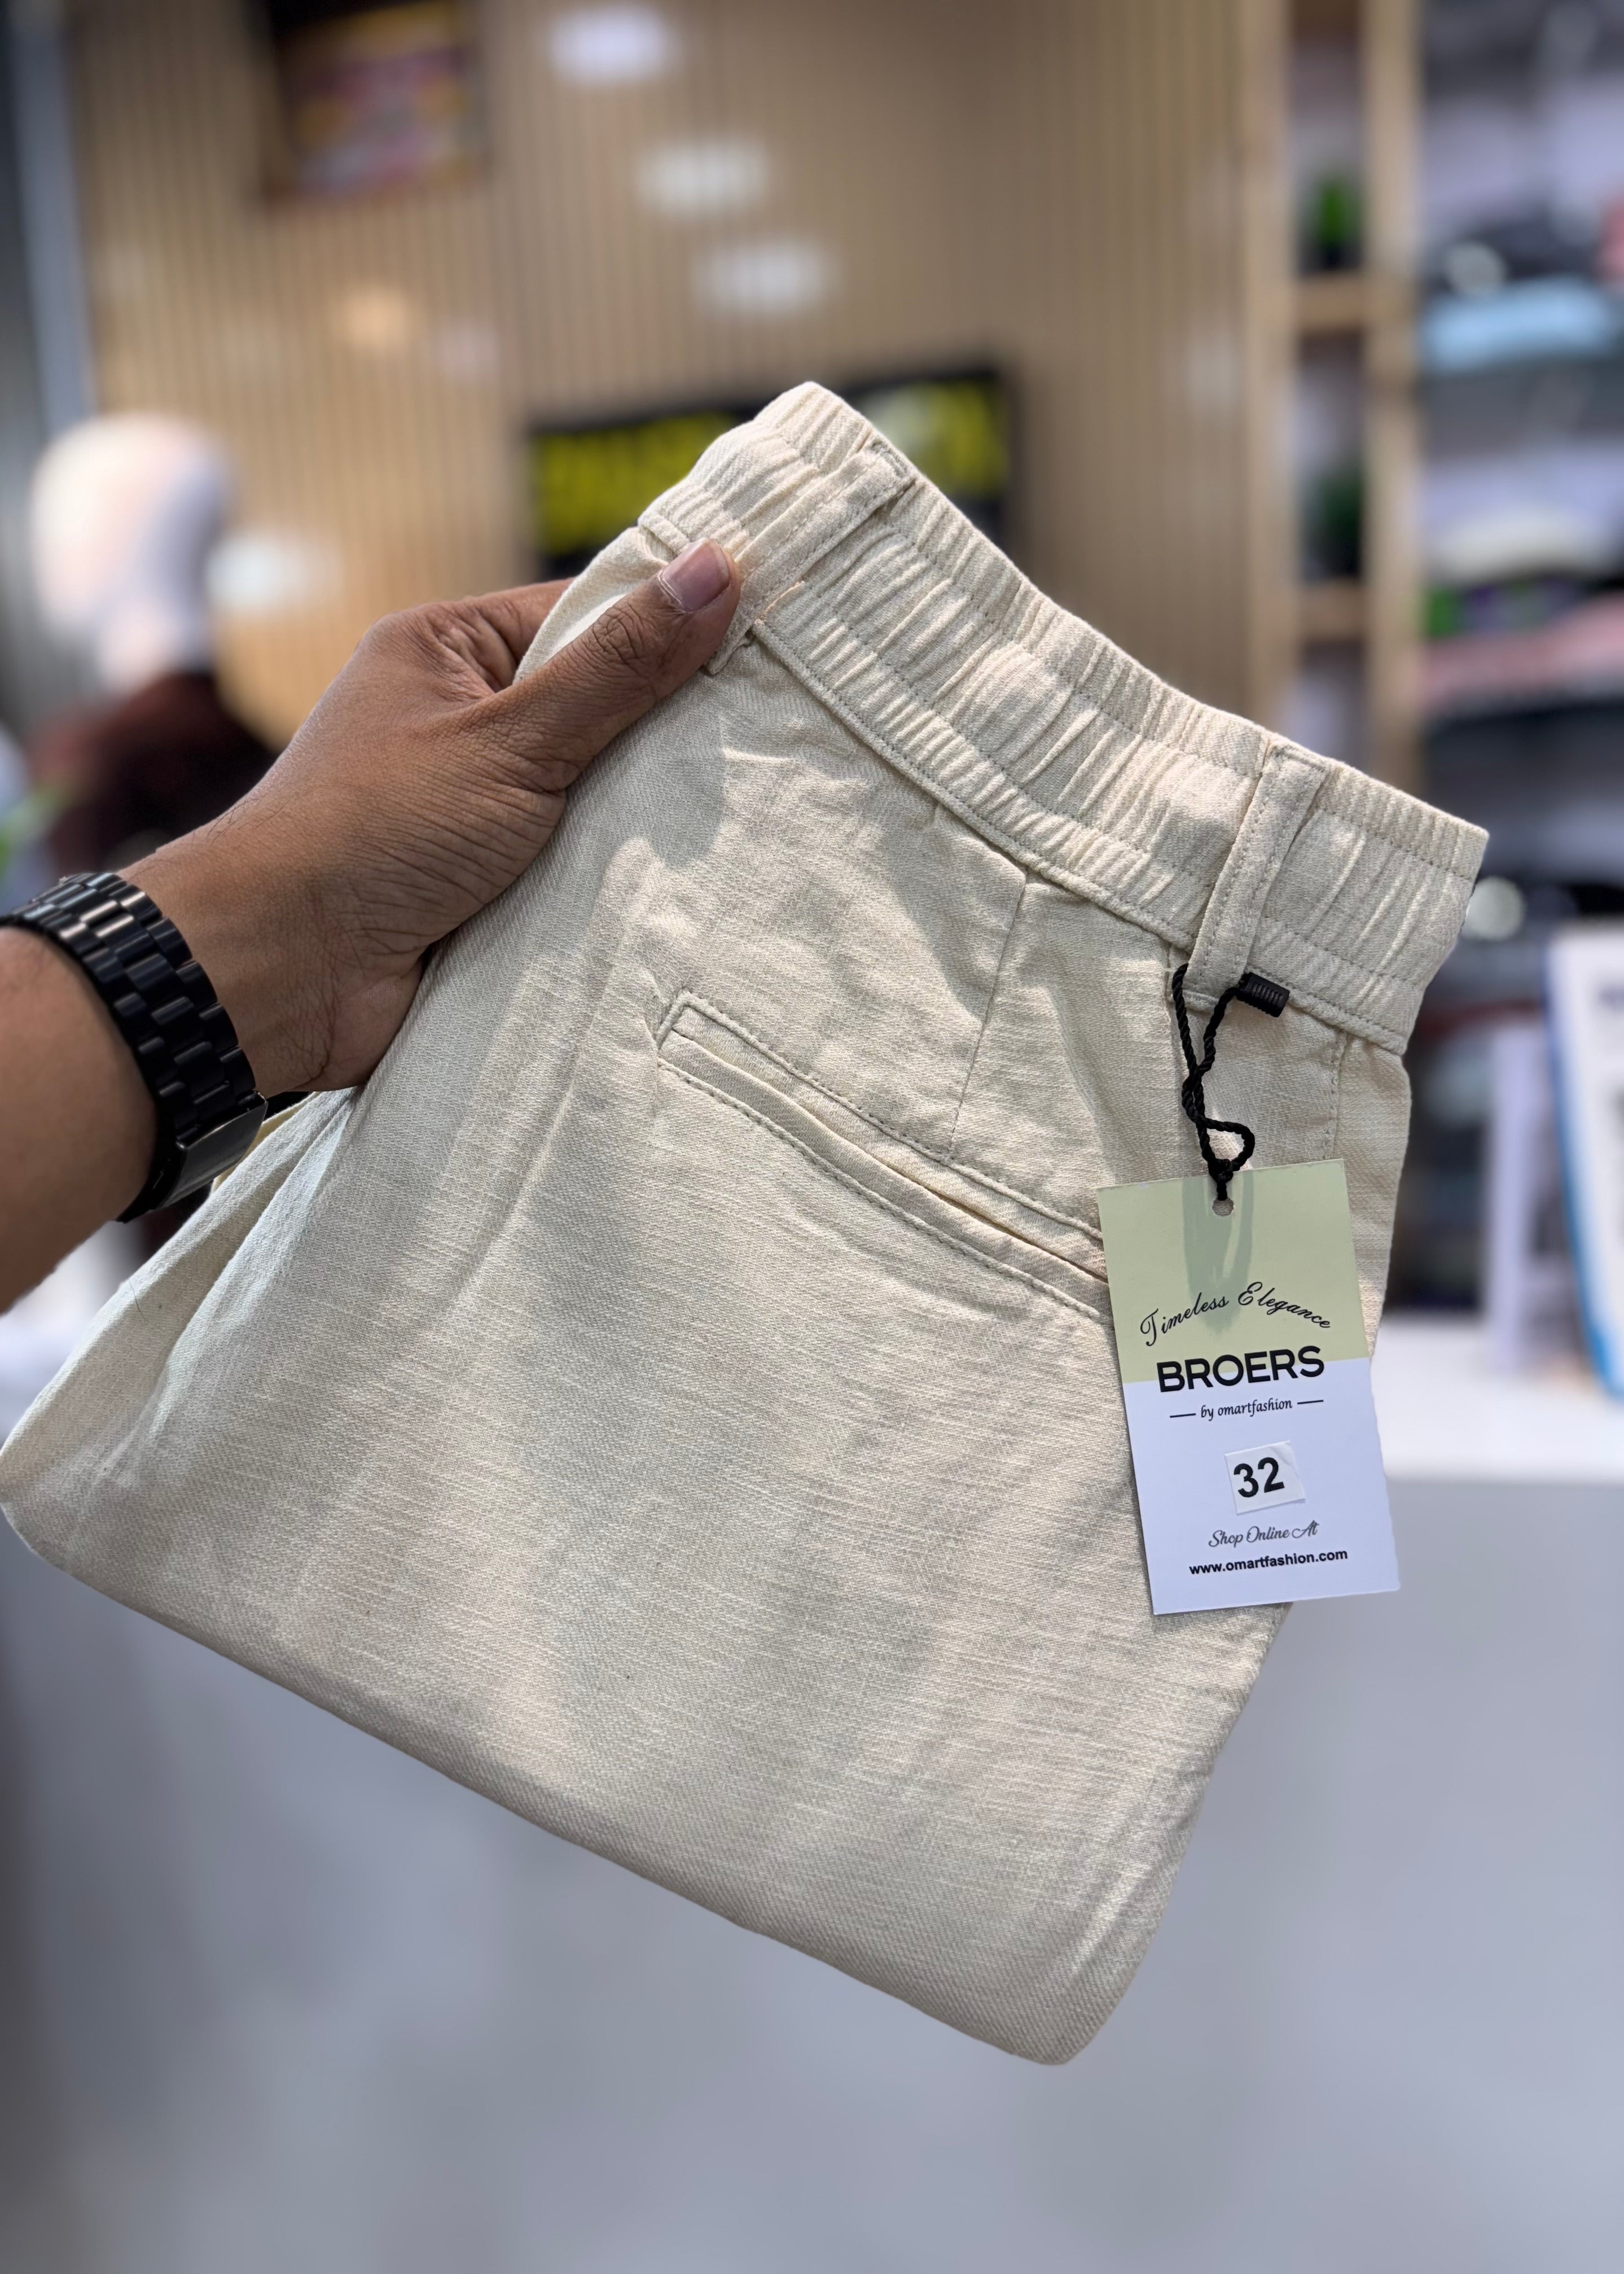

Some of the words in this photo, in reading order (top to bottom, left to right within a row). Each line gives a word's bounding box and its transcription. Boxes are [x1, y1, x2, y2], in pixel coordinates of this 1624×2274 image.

[1140, 1291, 1230, 1347] Timeless
[1237, 1281, 1331, 1328] Elegance
[1157, 1345, 1325, 1393] BROERS
[1201, 1404, 1214, 1422] by
[1218, 1397, 1293, 1417] omartfashion
[1233, 1457, 1285, 1498] 32
[1208, 1530, 1244, 1548] Shop
[1246, 1526, 1289, 1543] Online
[1292, 1520, 1319, 1539] At
[1188, 1550, 1348, 1575] www.omartfashion.com
